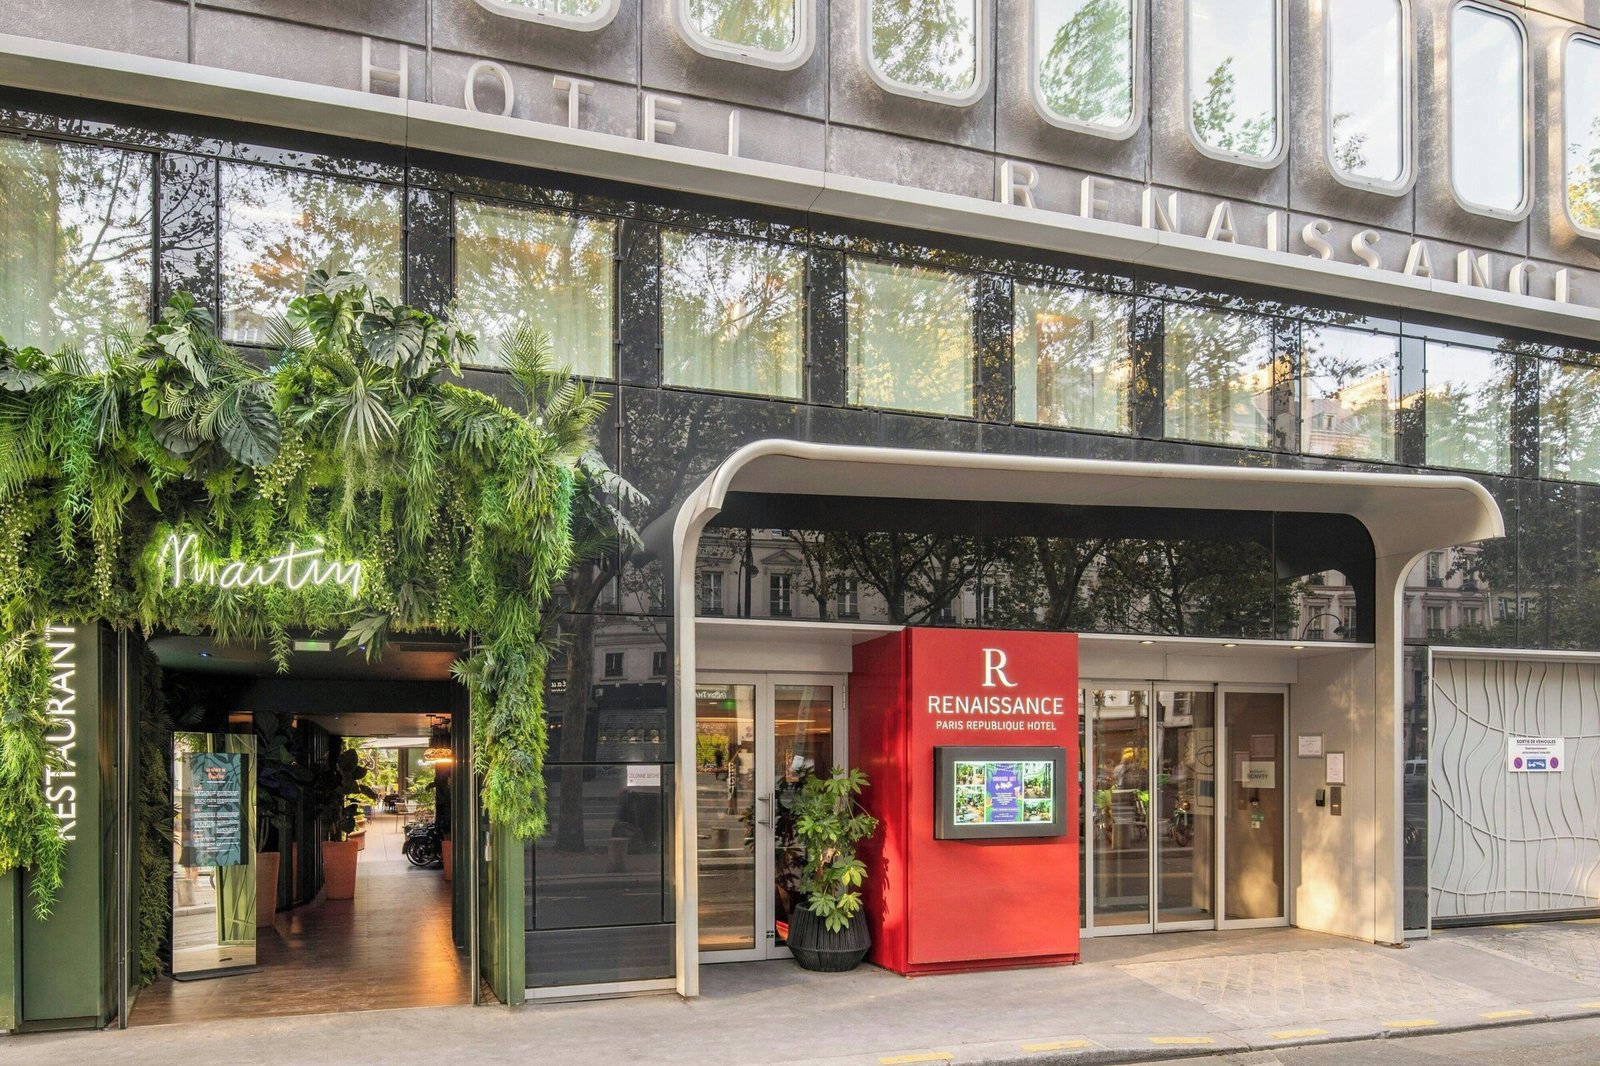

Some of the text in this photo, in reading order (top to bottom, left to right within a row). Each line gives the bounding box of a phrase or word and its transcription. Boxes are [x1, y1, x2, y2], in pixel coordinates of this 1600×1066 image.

[158, 534, 361, 597] Martin
[982, 648, 1018, 687] R
[928, 695, 1064, 715] RENAISSANCE
[936, 721, 1056, 731] PARIS REPUBLIQUE HOTEL
